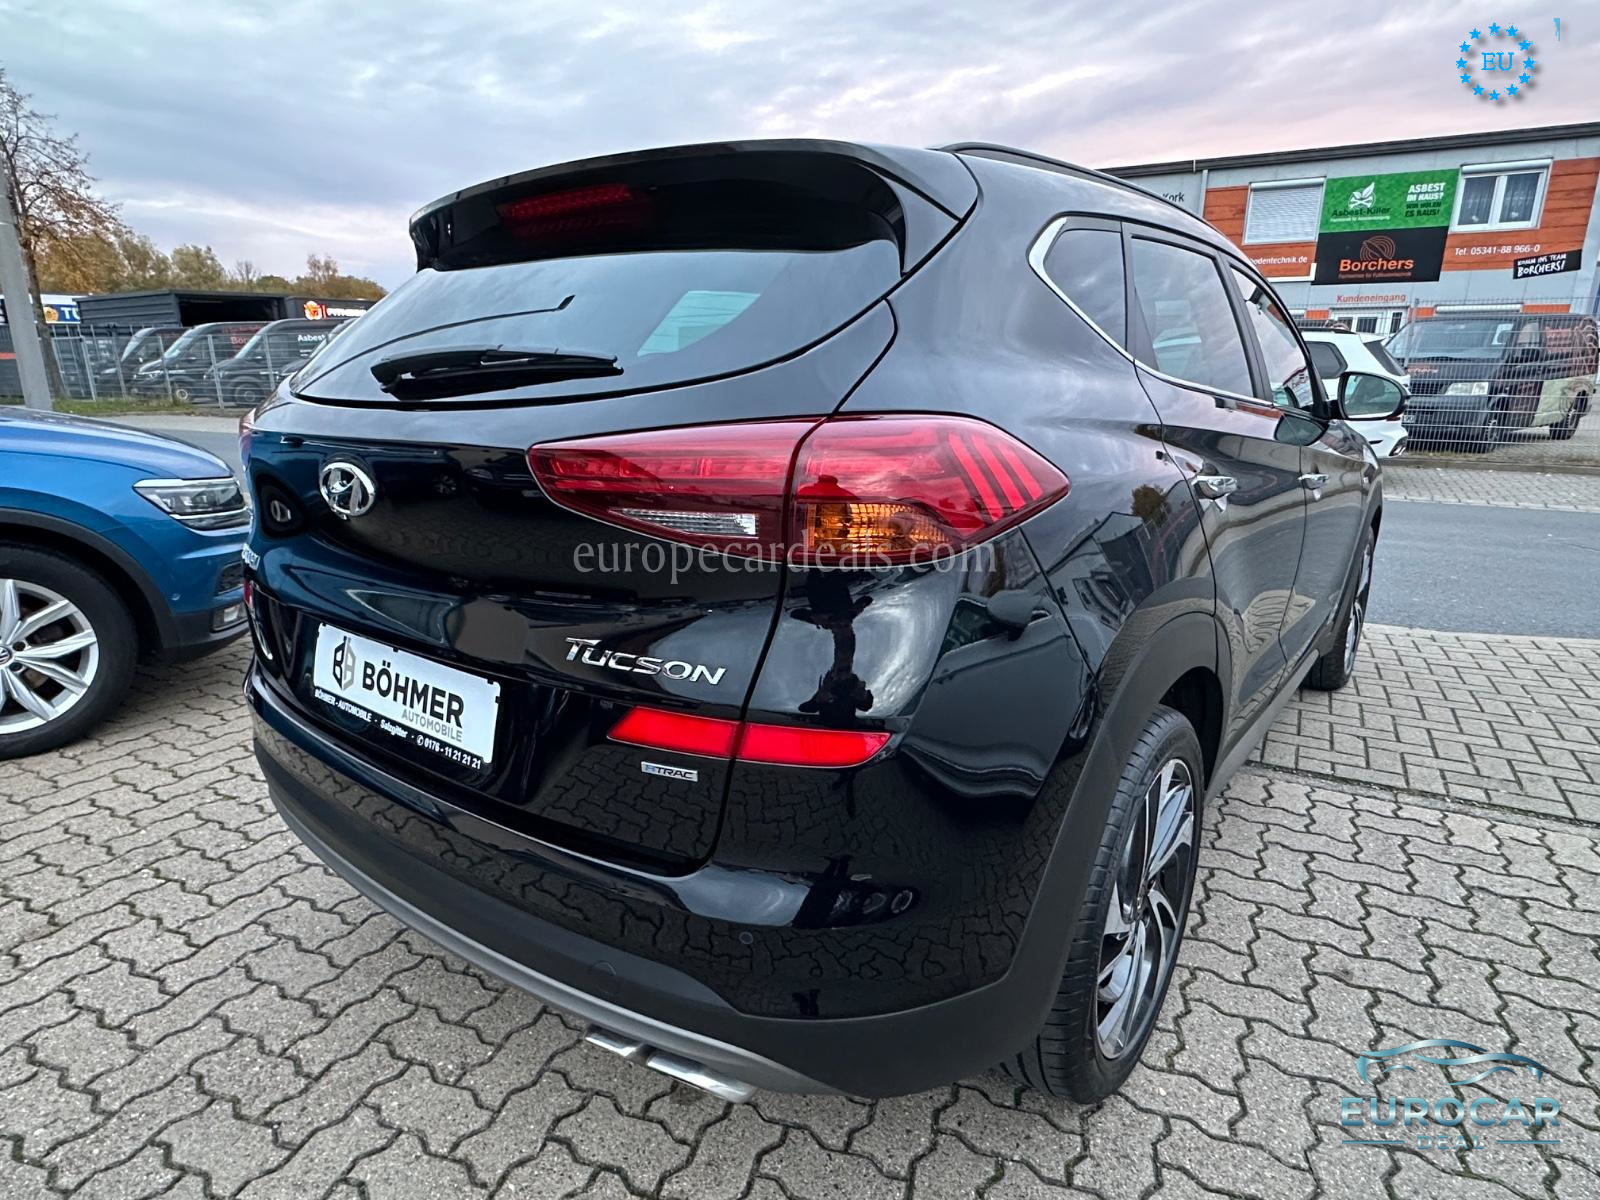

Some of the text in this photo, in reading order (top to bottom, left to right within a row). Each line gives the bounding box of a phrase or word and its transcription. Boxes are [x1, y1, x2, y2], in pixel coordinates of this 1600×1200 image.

[1408, 183, 1446, 193] ASBEST
[1331, 207, 1391, 217] Asbest-Killer
[1339, 258, 1414, 272] Borchers
[1517, 260, 1566, 277] BORCHERS!
[1337, 294, 1406, 304] Kundeneingang
[362, 659, 465, 729] BÖHMER
[402, 708, 463, 743] AUTOMOBILE
[444, 746, 453, 758] 11
[452, 749, 461, 762] 21
[462, 753, 471, 766] 21
[471, 757, 481, 770] 21
